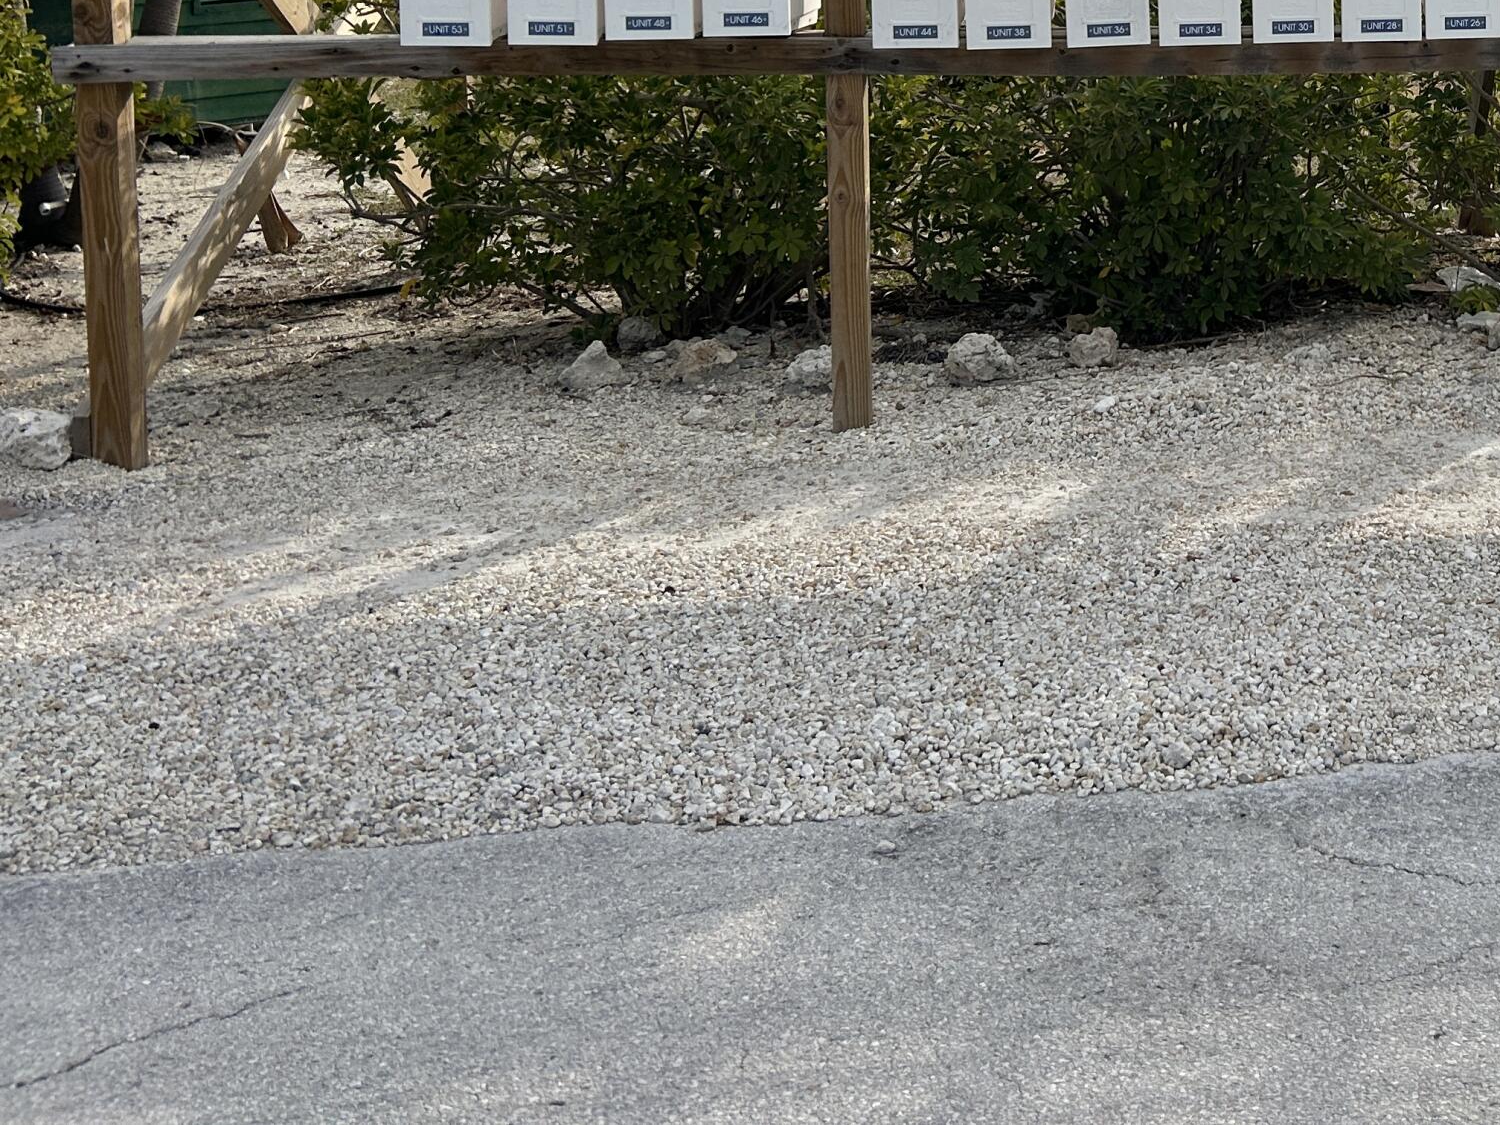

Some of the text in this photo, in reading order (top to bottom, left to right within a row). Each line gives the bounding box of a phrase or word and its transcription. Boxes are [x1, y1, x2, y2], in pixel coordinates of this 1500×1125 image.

[632, 18, 652, 28] UNIT
[729, 15, 763, 24] UNIT 46
[1450, 19, 1481, 27] UNIT 26
[428, 25, 463, 34] UNIT 53
[534, 24, 567, 33] UNIT 51
[1093, 25, 1125, 35] UNIT 36
[1185, 25, 1216, 34] UNIT 34
[1278, 22, 1309, 32] UNIT 30
[1367, 21, 1397, 30] UNIT 28
[899, 27, 932, 37] UNIT 44
[993, 28, 1025, 37] UNIT 38
